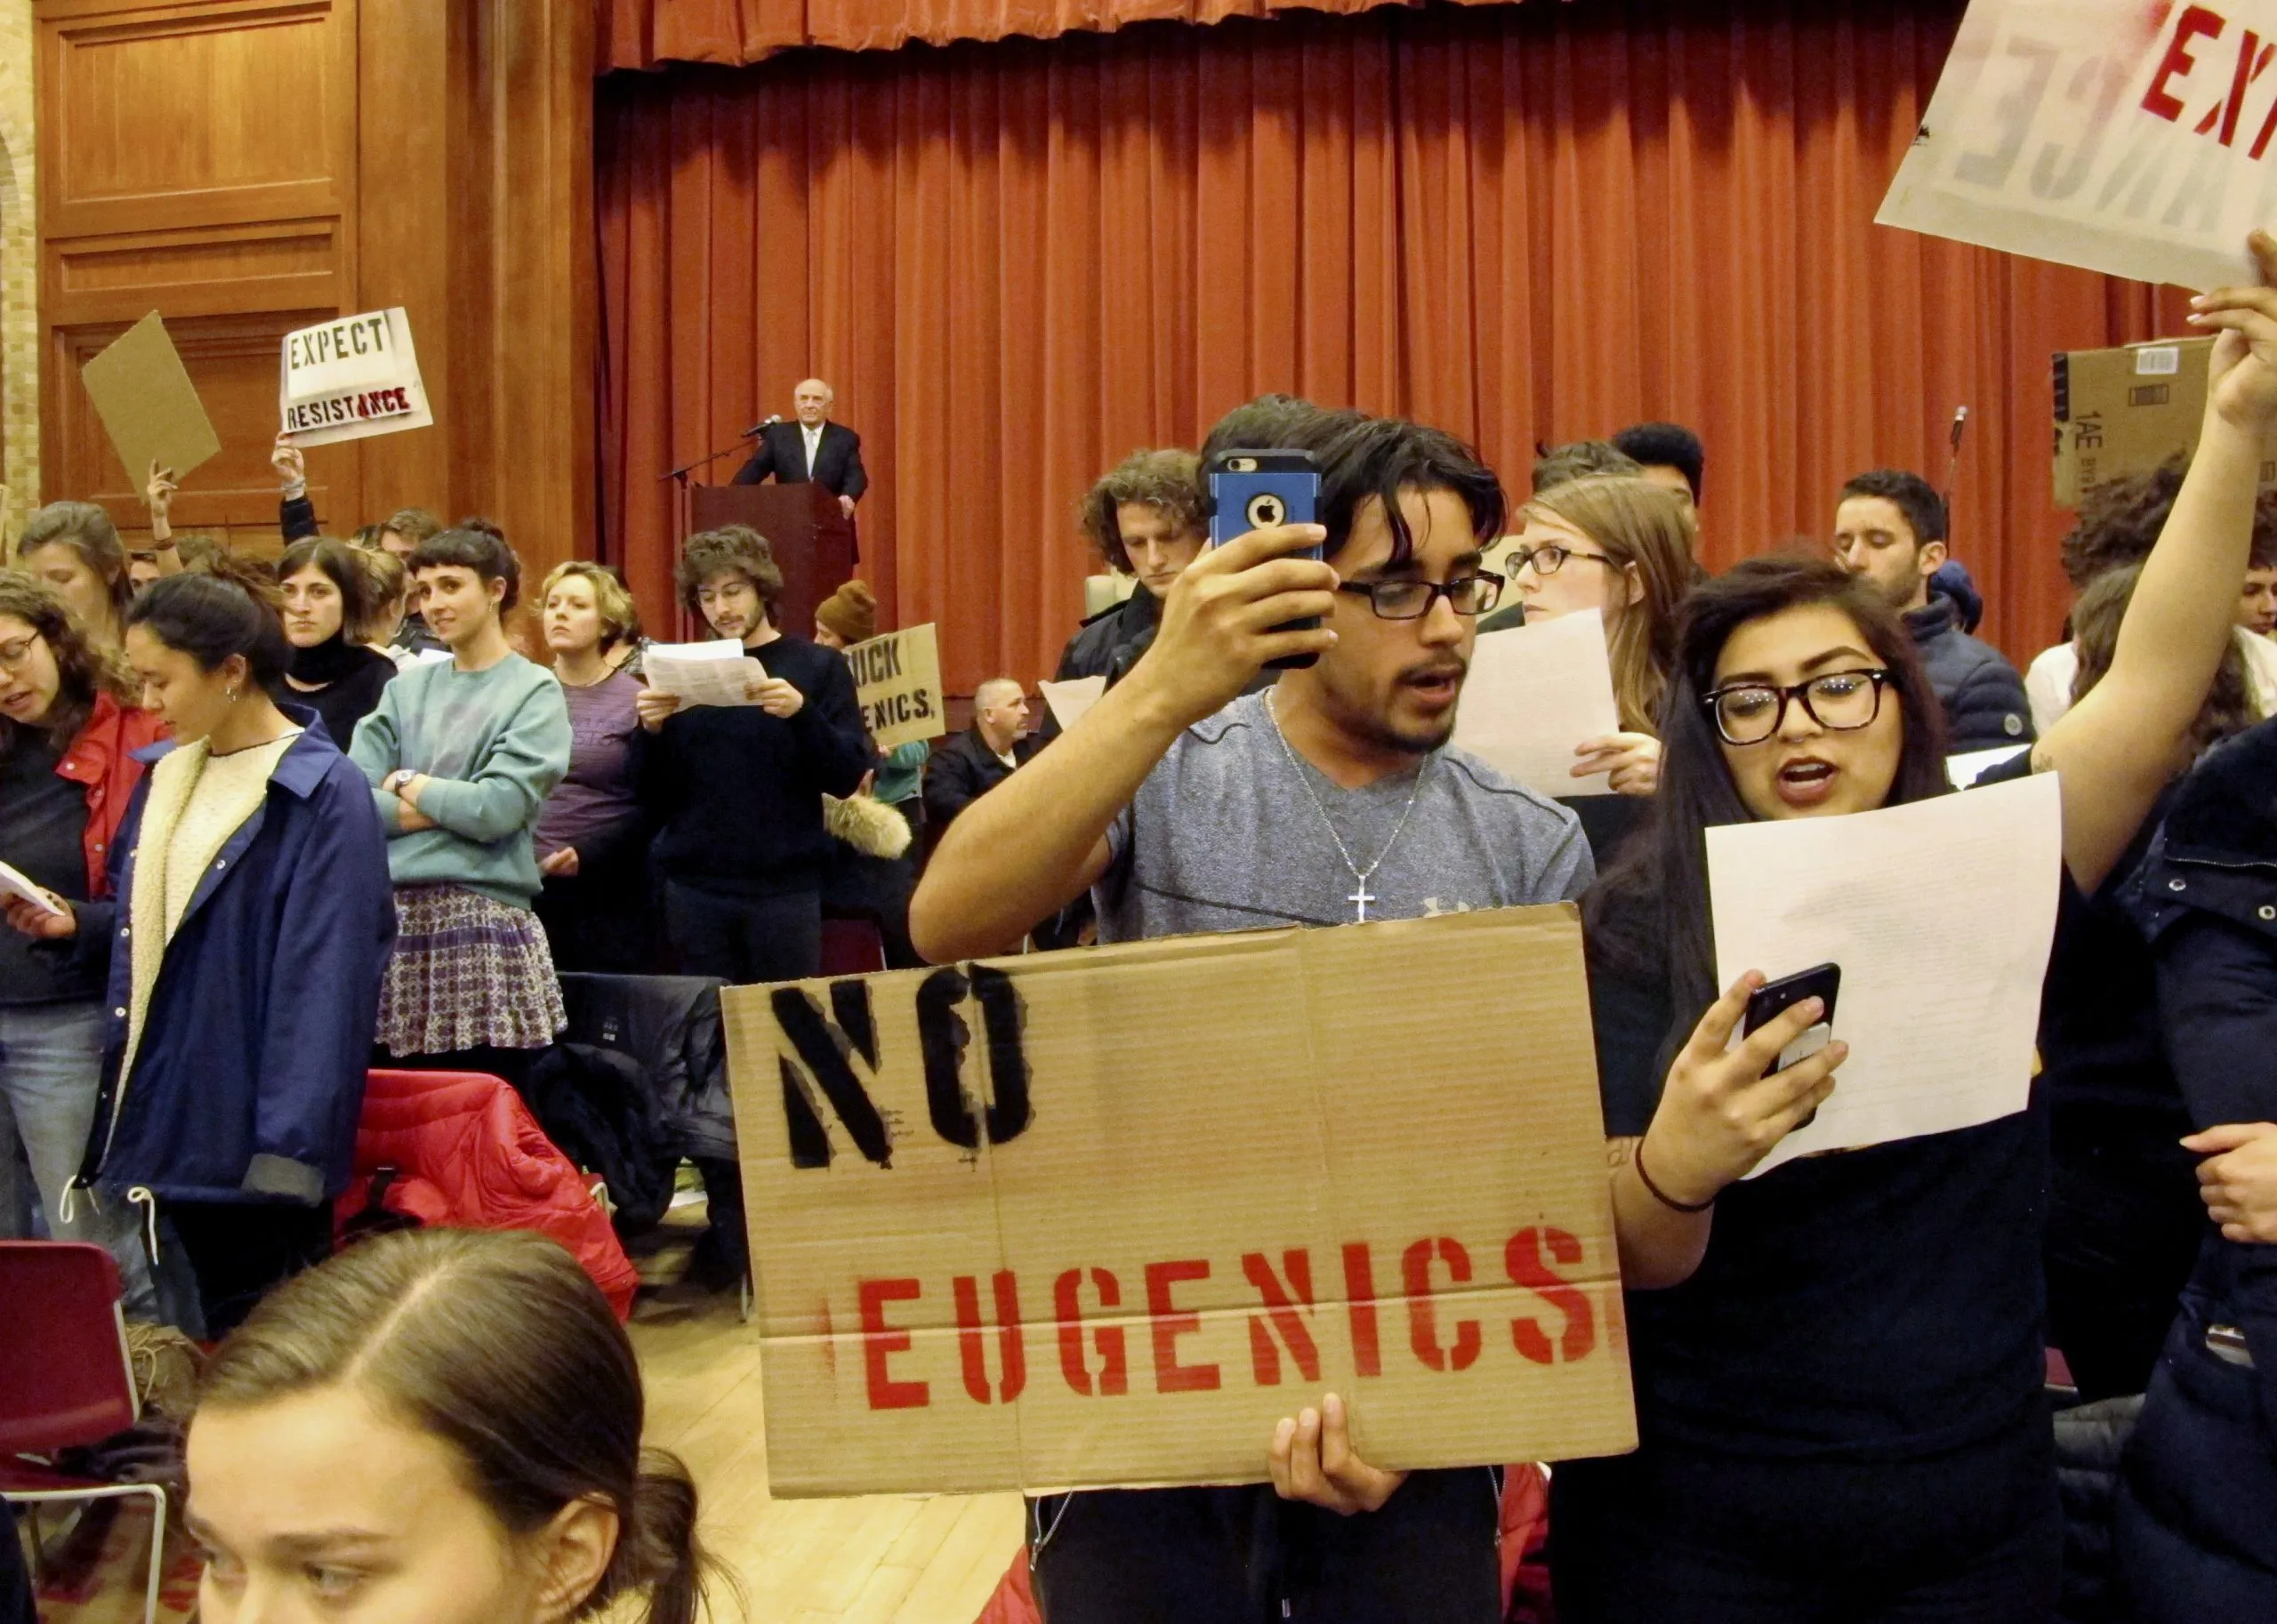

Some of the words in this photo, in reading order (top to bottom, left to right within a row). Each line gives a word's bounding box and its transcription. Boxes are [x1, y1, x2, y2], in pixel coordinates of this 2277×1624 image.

[291, 318, 383, 370] EXPECT
[287, 387, 410, 430] RESISTANCE
[771, 961, 1036, 1170] NO
[858, 1226, 1597, 1410] EUGENICS
